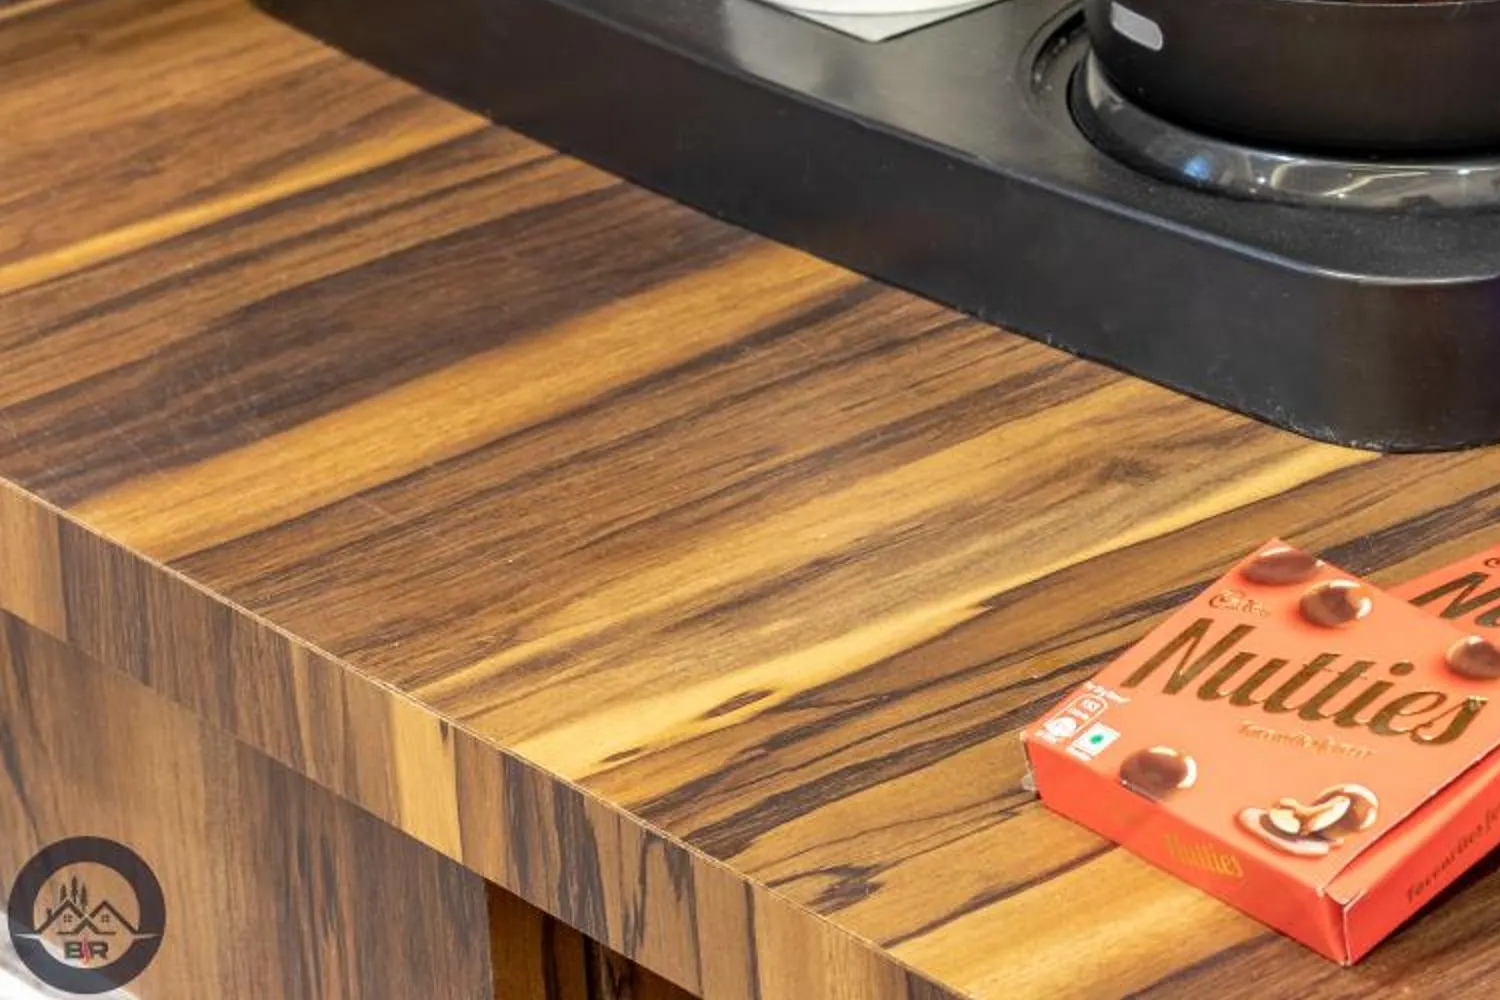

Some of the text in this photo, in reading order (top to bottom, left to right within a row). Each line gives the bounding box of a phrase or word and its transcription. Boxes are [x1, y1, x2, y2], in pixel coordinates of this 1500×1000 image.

[1120, 617, 1488, 746] Nutties
[1163, 831, 1244, 879] Nutties
[1406, 823, 1484, 904] Favourites
